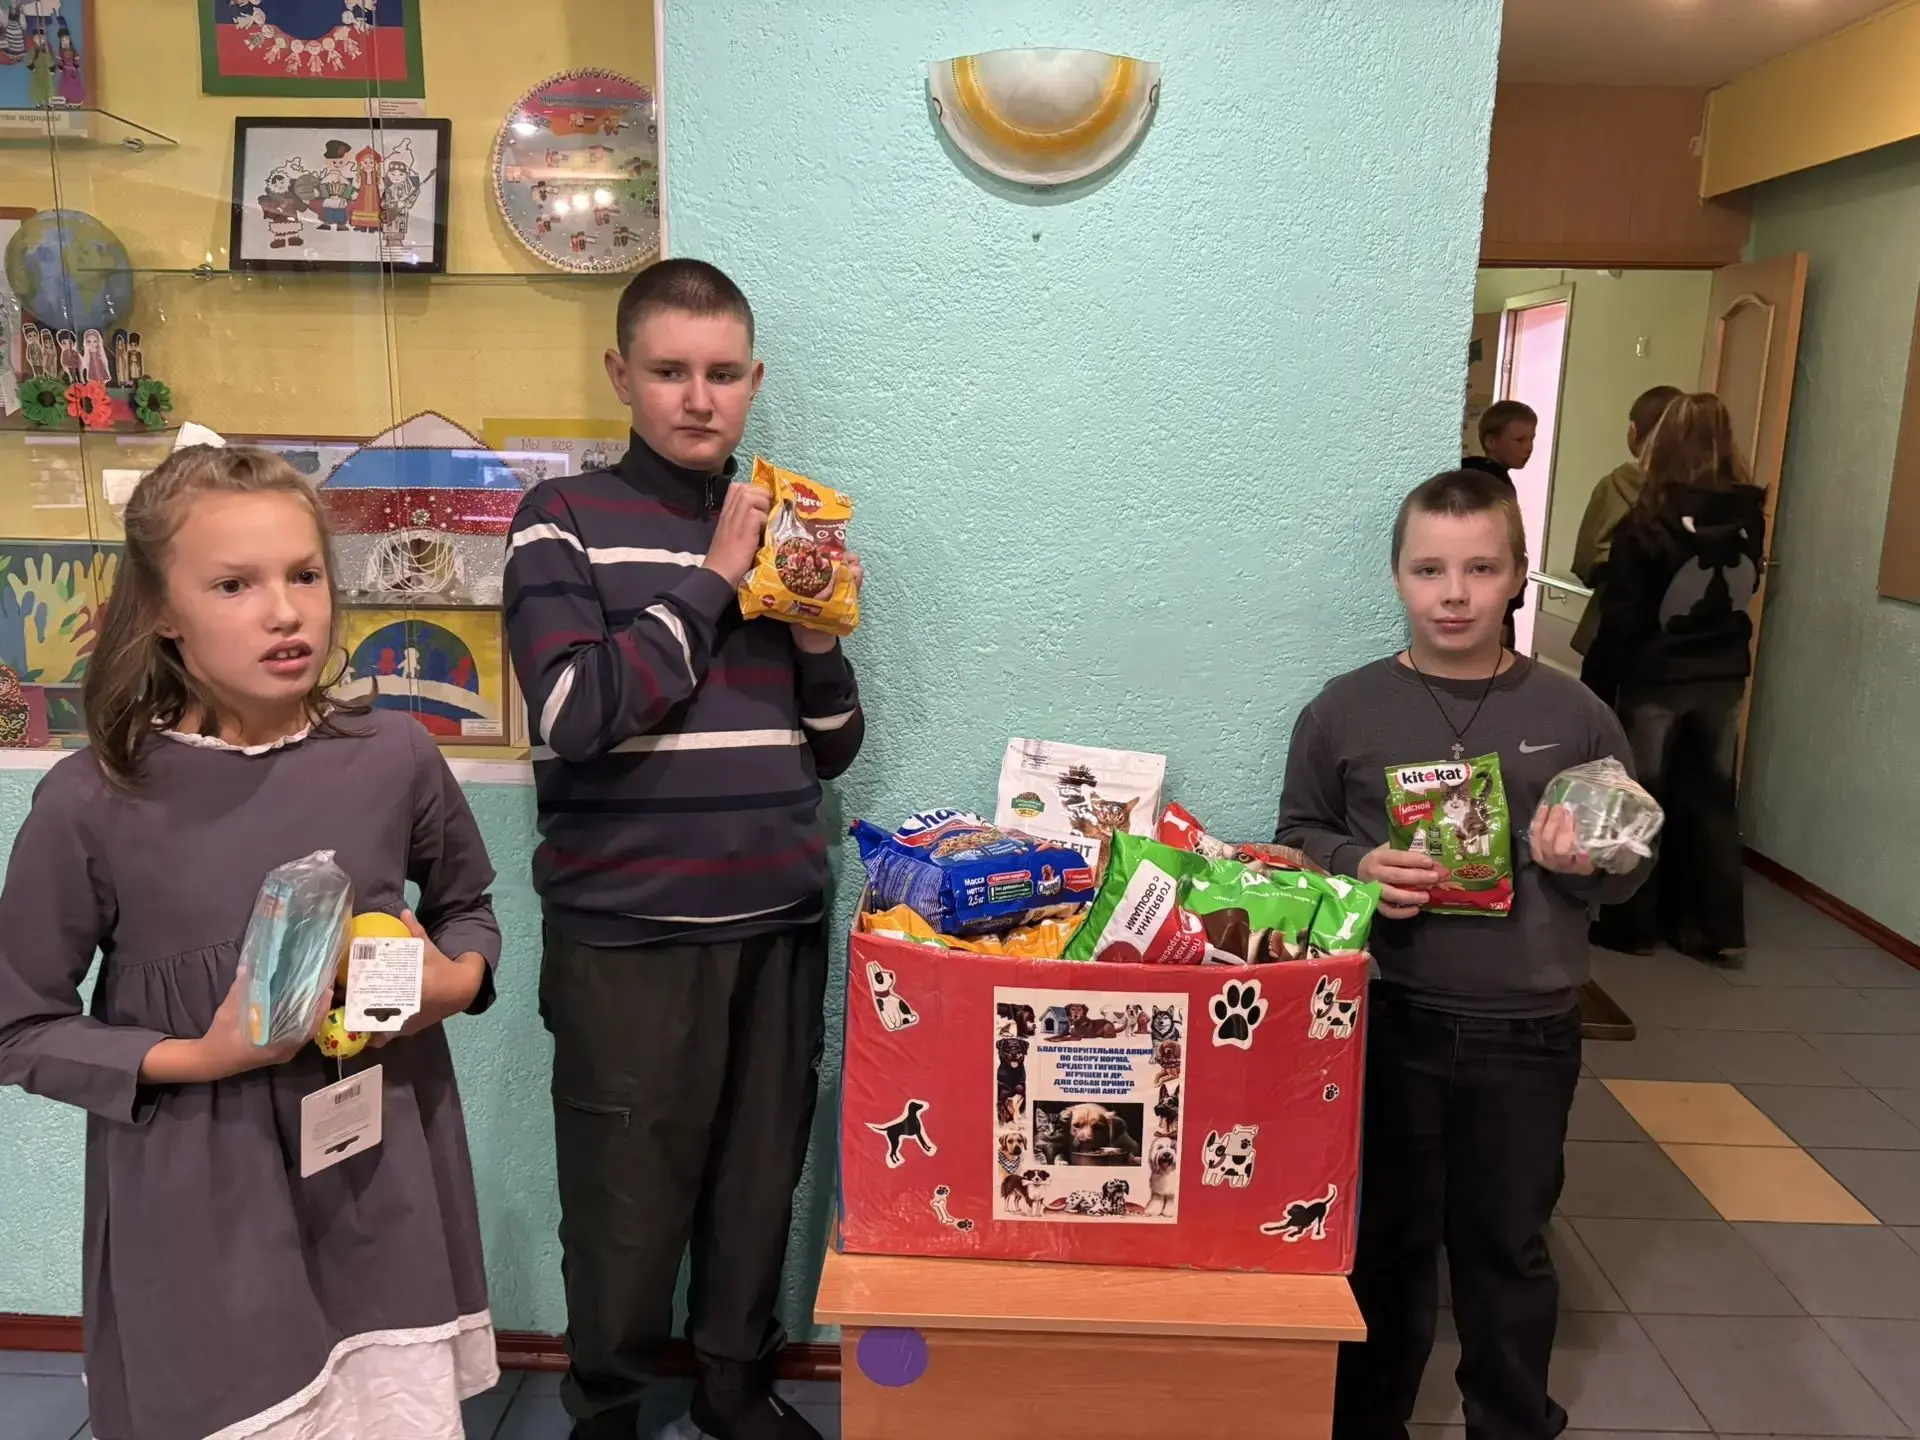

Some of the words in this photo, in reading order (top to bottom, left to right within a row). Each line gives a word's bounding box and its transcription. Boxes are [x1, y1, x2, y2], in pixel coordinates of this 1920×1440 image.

[521, 438, 540, 450] Мы
[1402, 767, 1464, 785] kitekat
[965, 877, 985, 886] Масса
[1125, 884, 1158, 931] ОВОЩАМИ
[1135, 881, 1171, 936] ГОВЯДИНА
